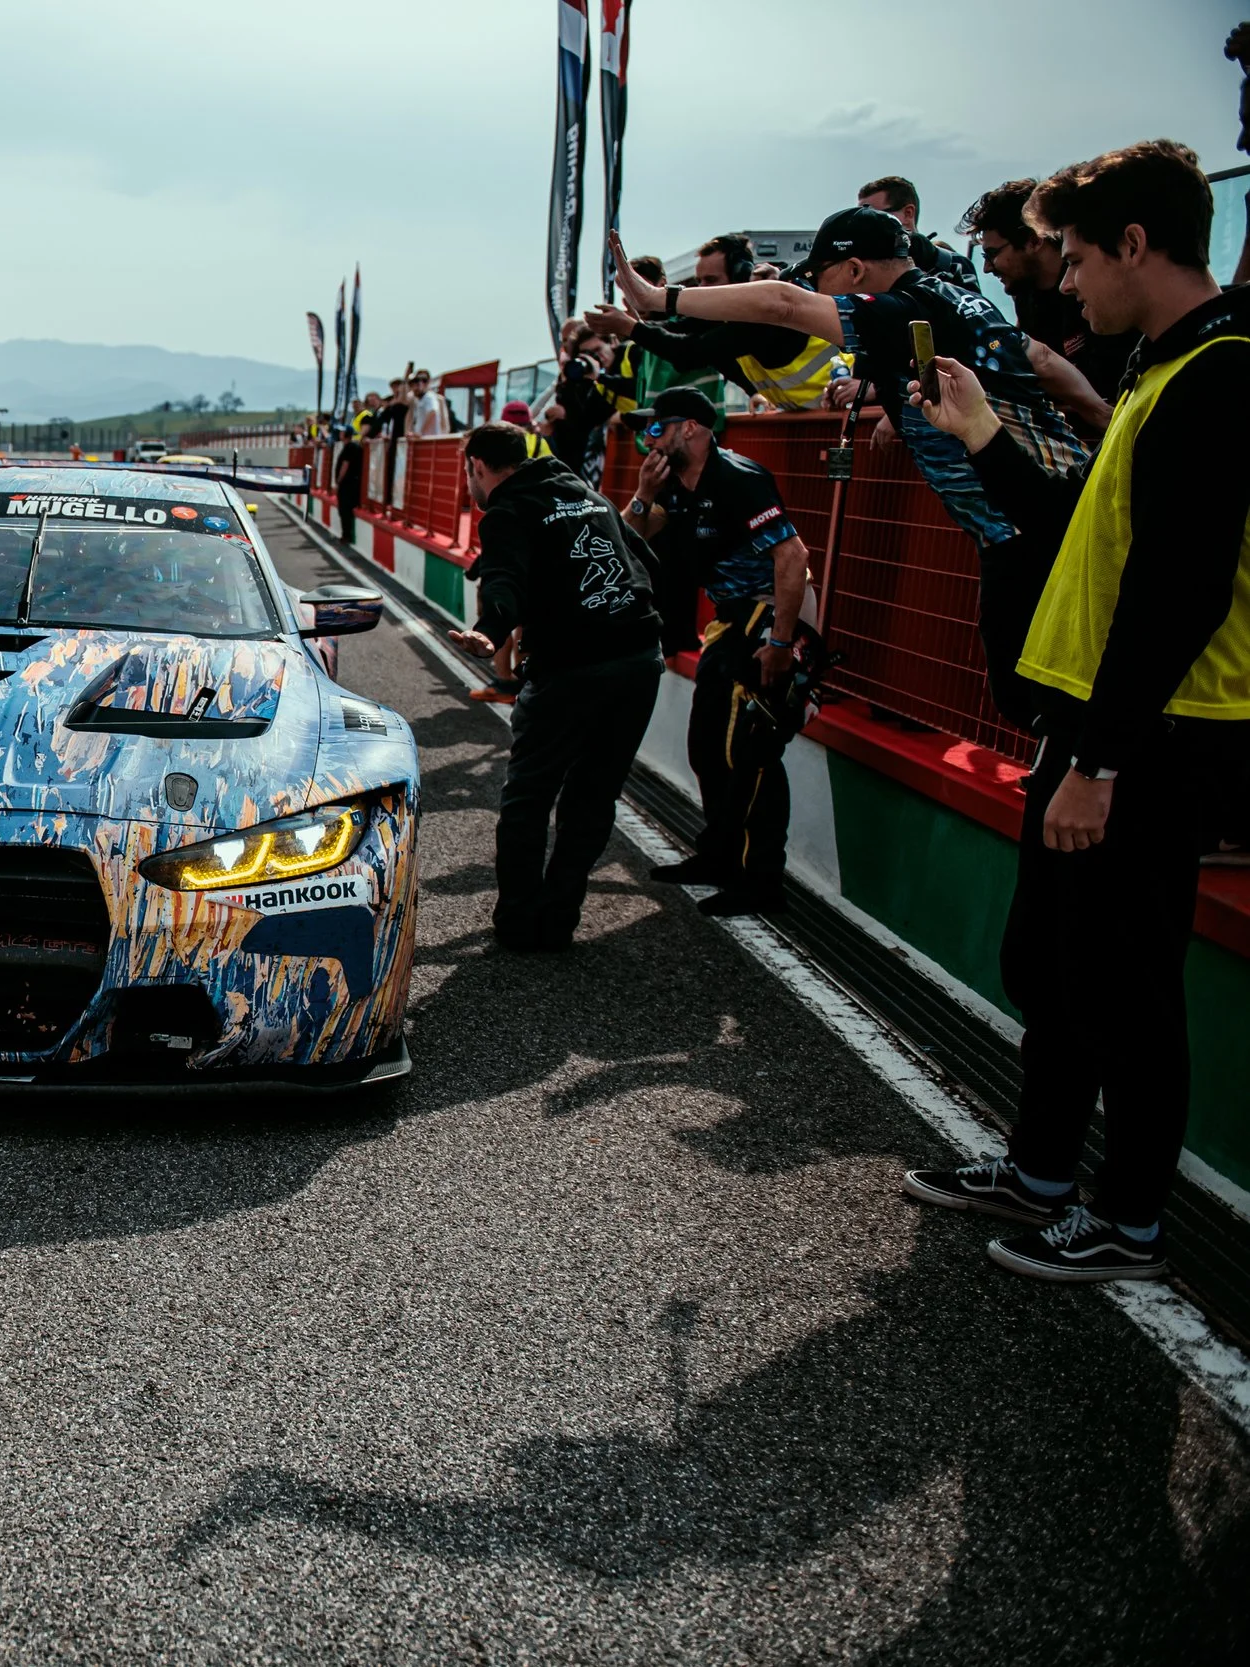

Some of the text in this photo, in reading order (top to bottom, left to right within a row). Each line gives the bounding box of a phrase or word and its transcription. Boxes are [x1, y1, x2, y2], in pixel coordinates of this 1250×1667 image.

[7, 500, 167, 525] MUGELLO
[543, 509, 567, 525] TEAM
[750, 507, 780, 529] MOTUL
